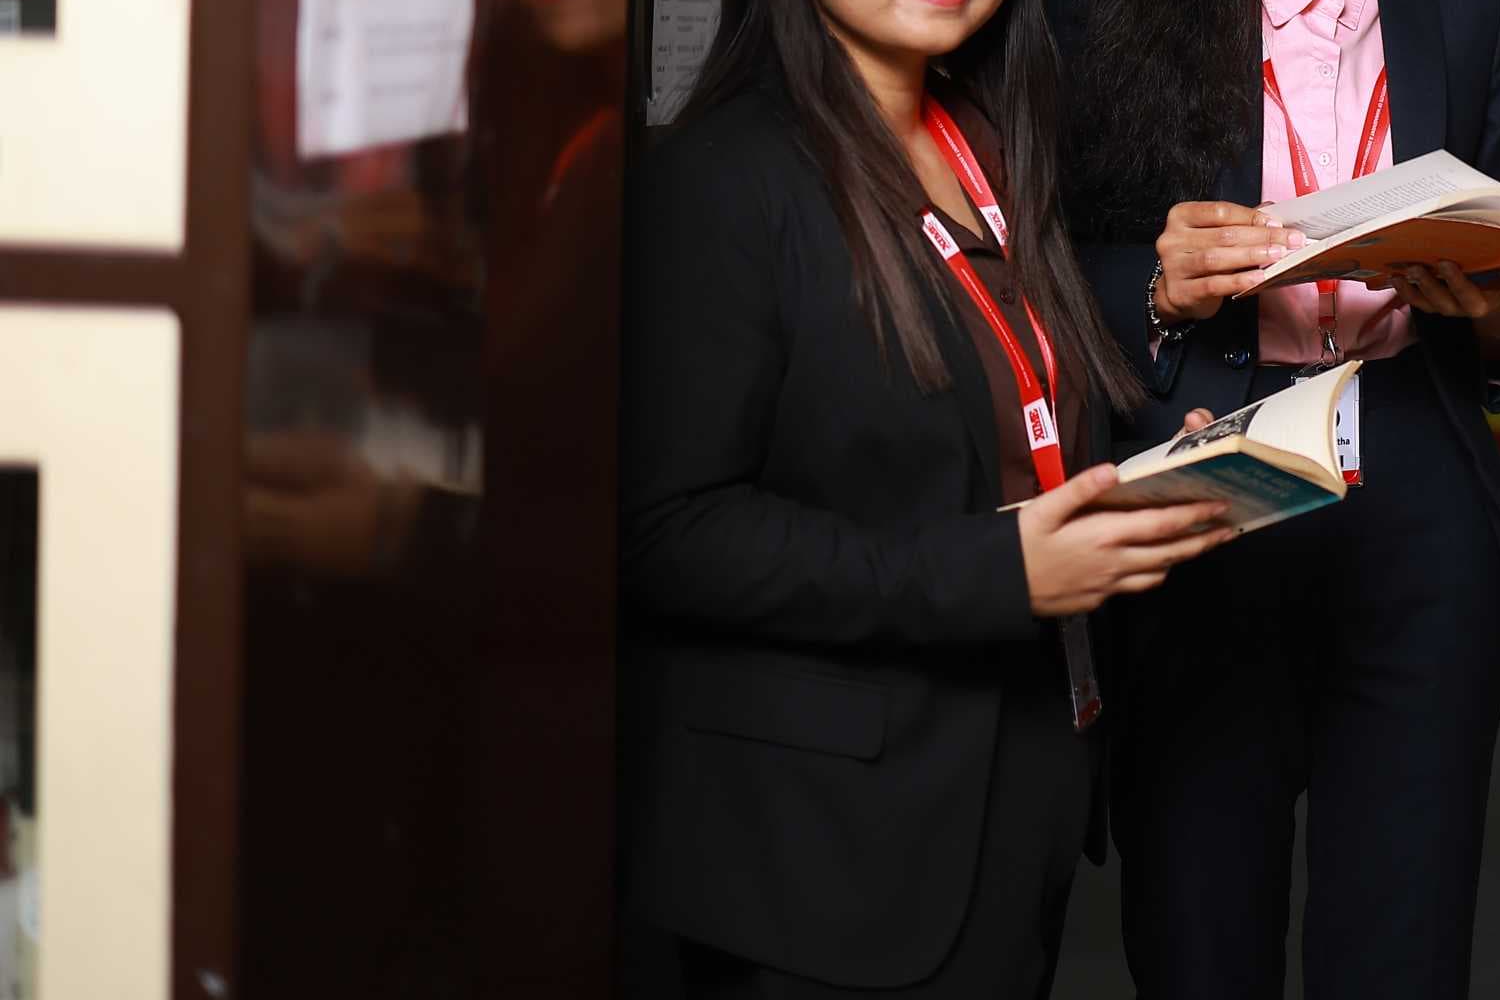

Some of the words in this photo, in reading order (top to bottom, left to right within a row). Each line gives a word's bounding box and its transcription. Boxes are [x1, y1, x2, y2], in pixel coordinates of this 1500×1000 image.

[928, 221, 949, 251] XIME
[1029, 407, 1045, 442] XIME
[1337, 437, 1350, 446] tha
